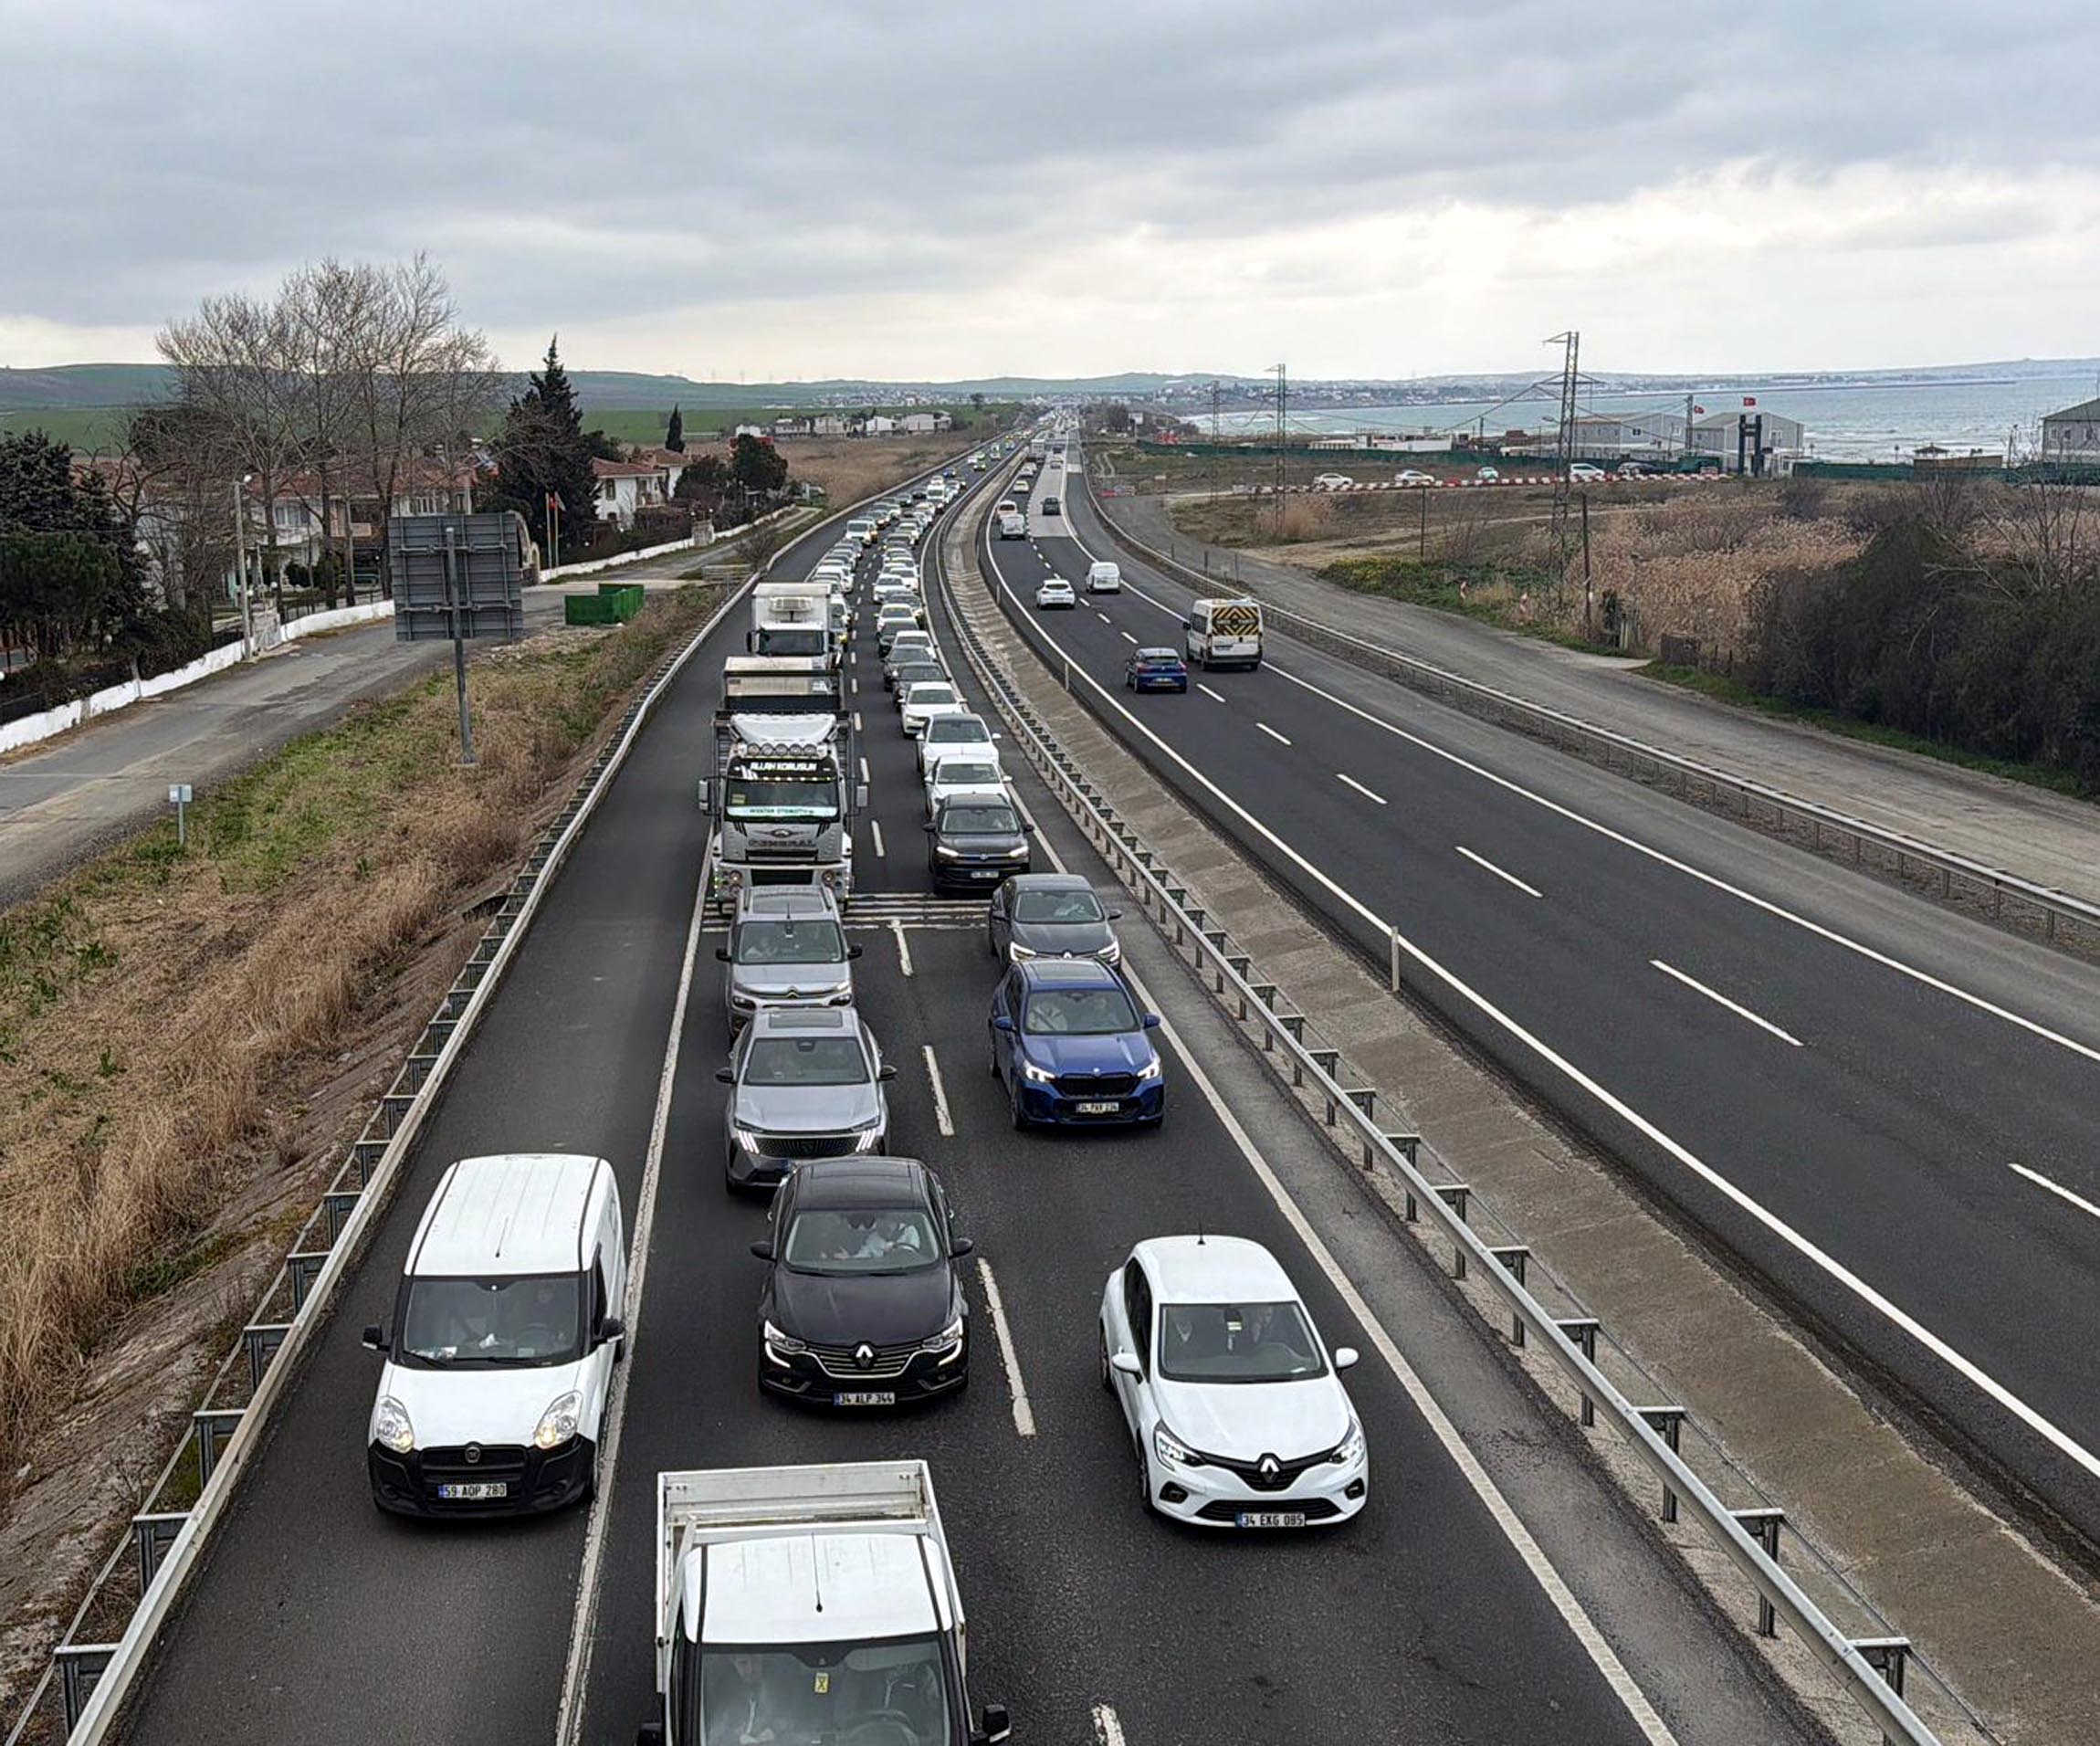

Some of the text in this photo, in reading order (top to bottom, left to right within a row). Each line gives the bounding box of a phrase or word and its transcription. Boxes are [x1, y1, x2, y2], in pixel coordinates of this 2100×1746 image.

[840, 1394, 851, 1404] 34
[876, 1394, 893, 1404] 344
[446, 1486, 457, 1497] 59
[486, 1485, 505, 1496] 280
[1243, 1513, 1255, 1526] 34
[1284, 1513, 1304, 1526] 085
